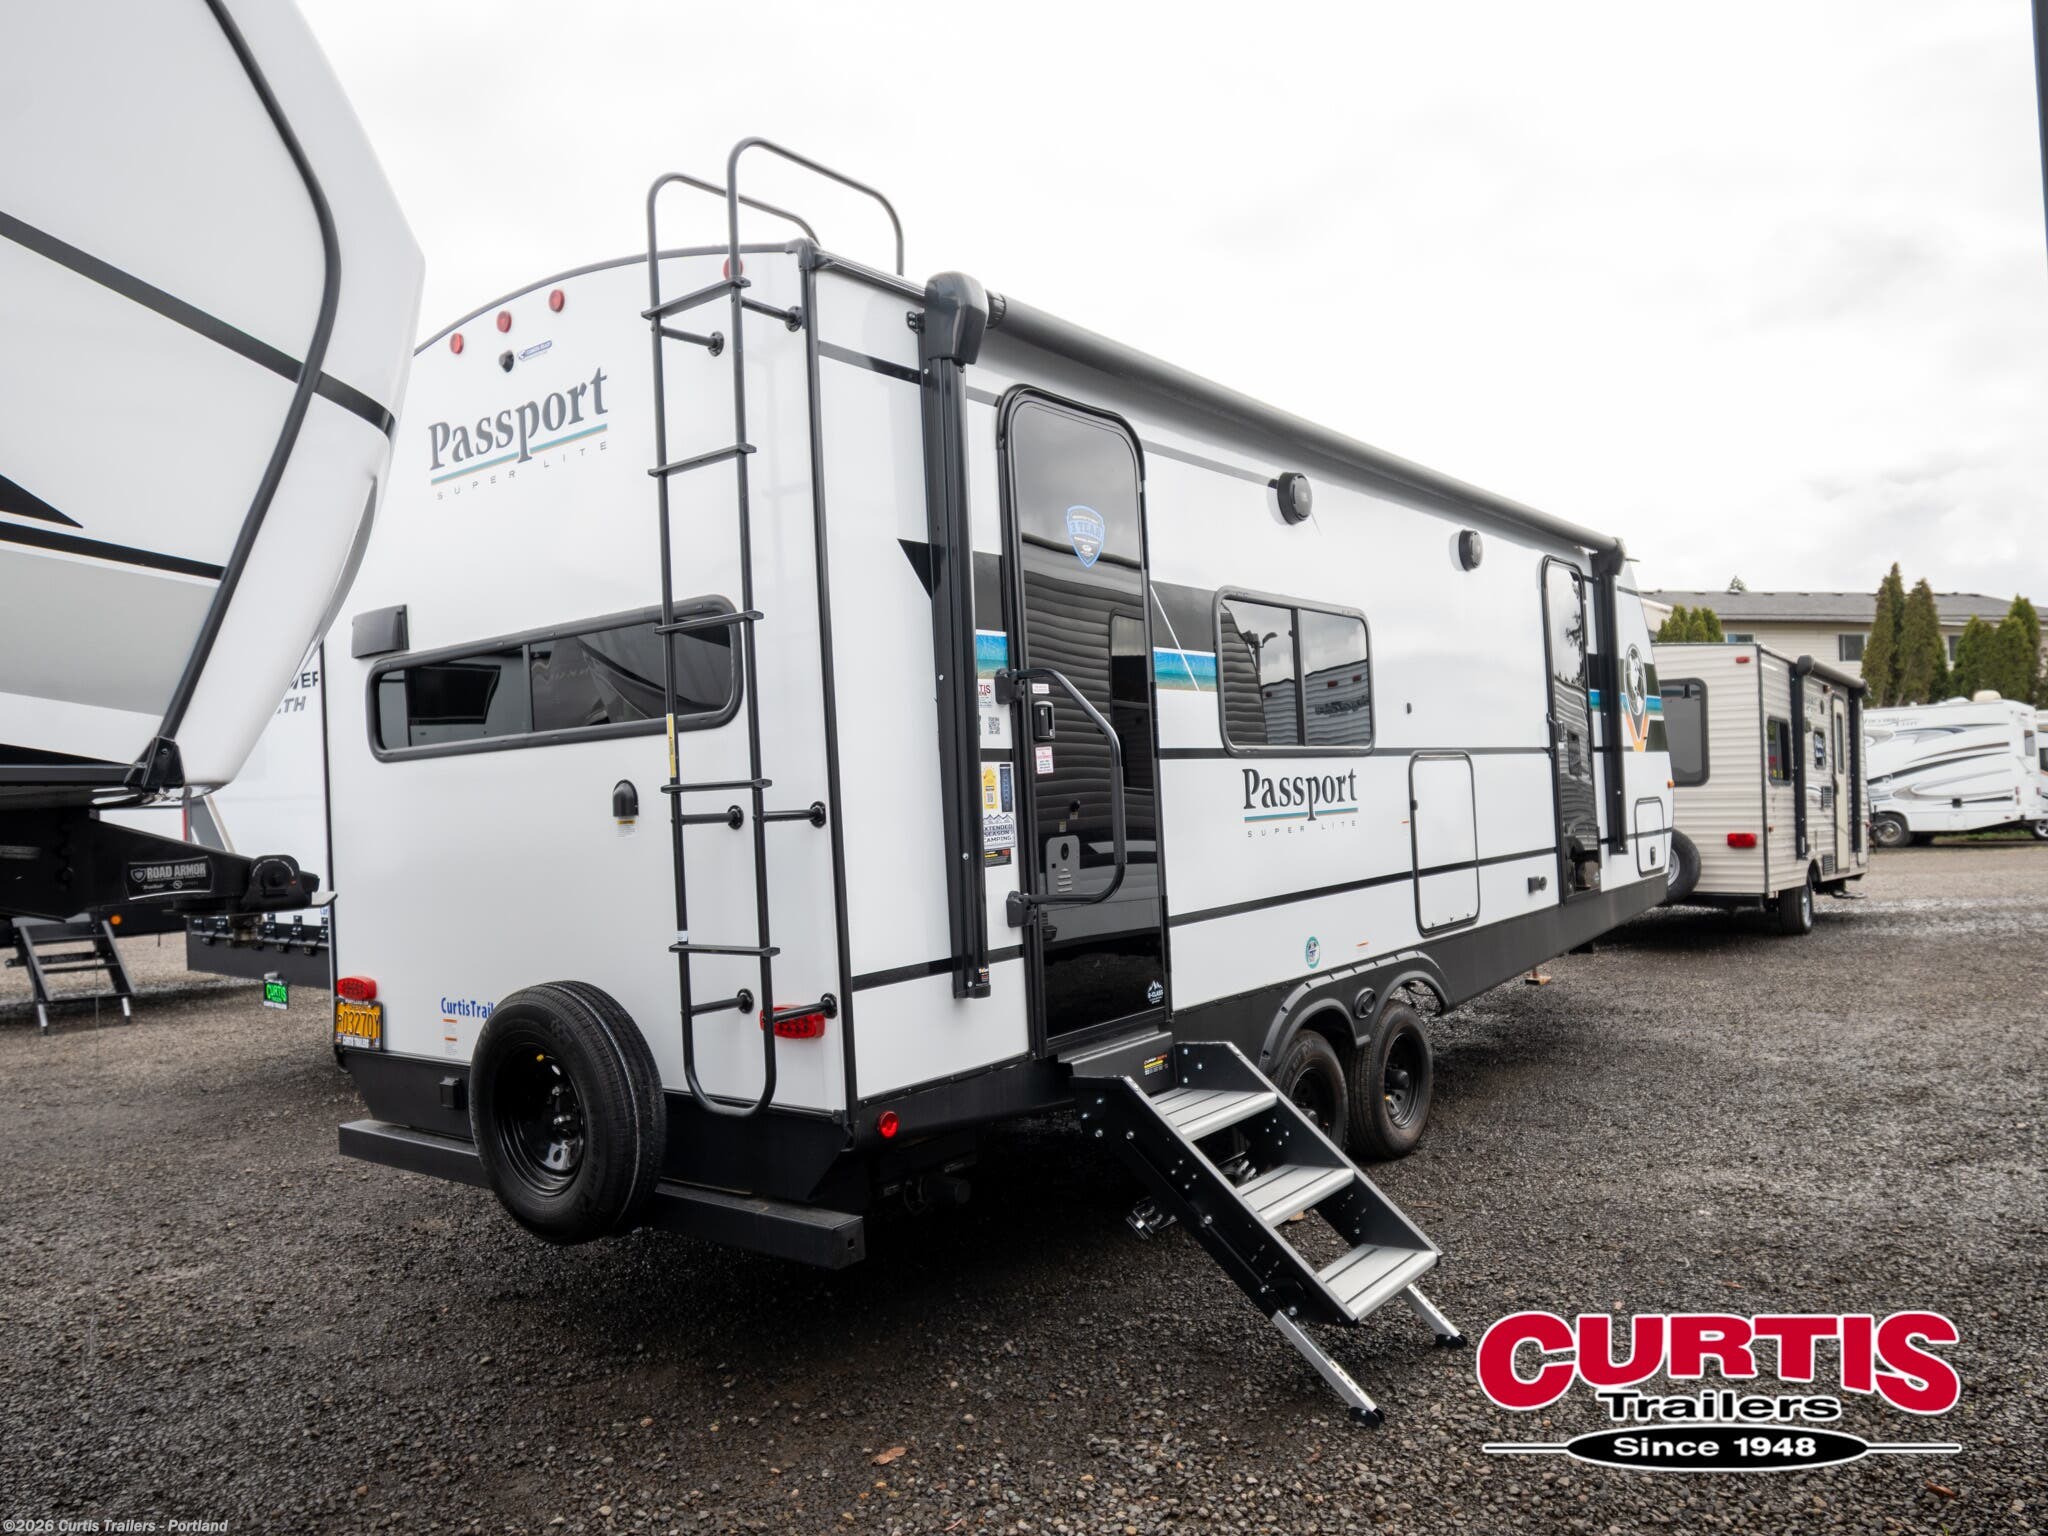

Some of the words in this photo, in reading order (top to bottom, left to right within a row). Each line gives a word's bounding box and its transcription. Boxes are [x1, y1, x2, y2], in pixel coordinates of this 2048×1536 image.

[428, 367, 608, 471] Passport
[437, 470, 516, 500] SUPER
[543, 441, 607, 468] LITE
[1242, 768, 1358, 821] Passport
[984, 823, 1013, 831] XTENDED
[1247, 826, 1305, 837] SUPER
[1321, 820, 1356, 831] LITE
[147, 865, 172, 879] ROAD
[174, 863, 206, 877] ARMOR
